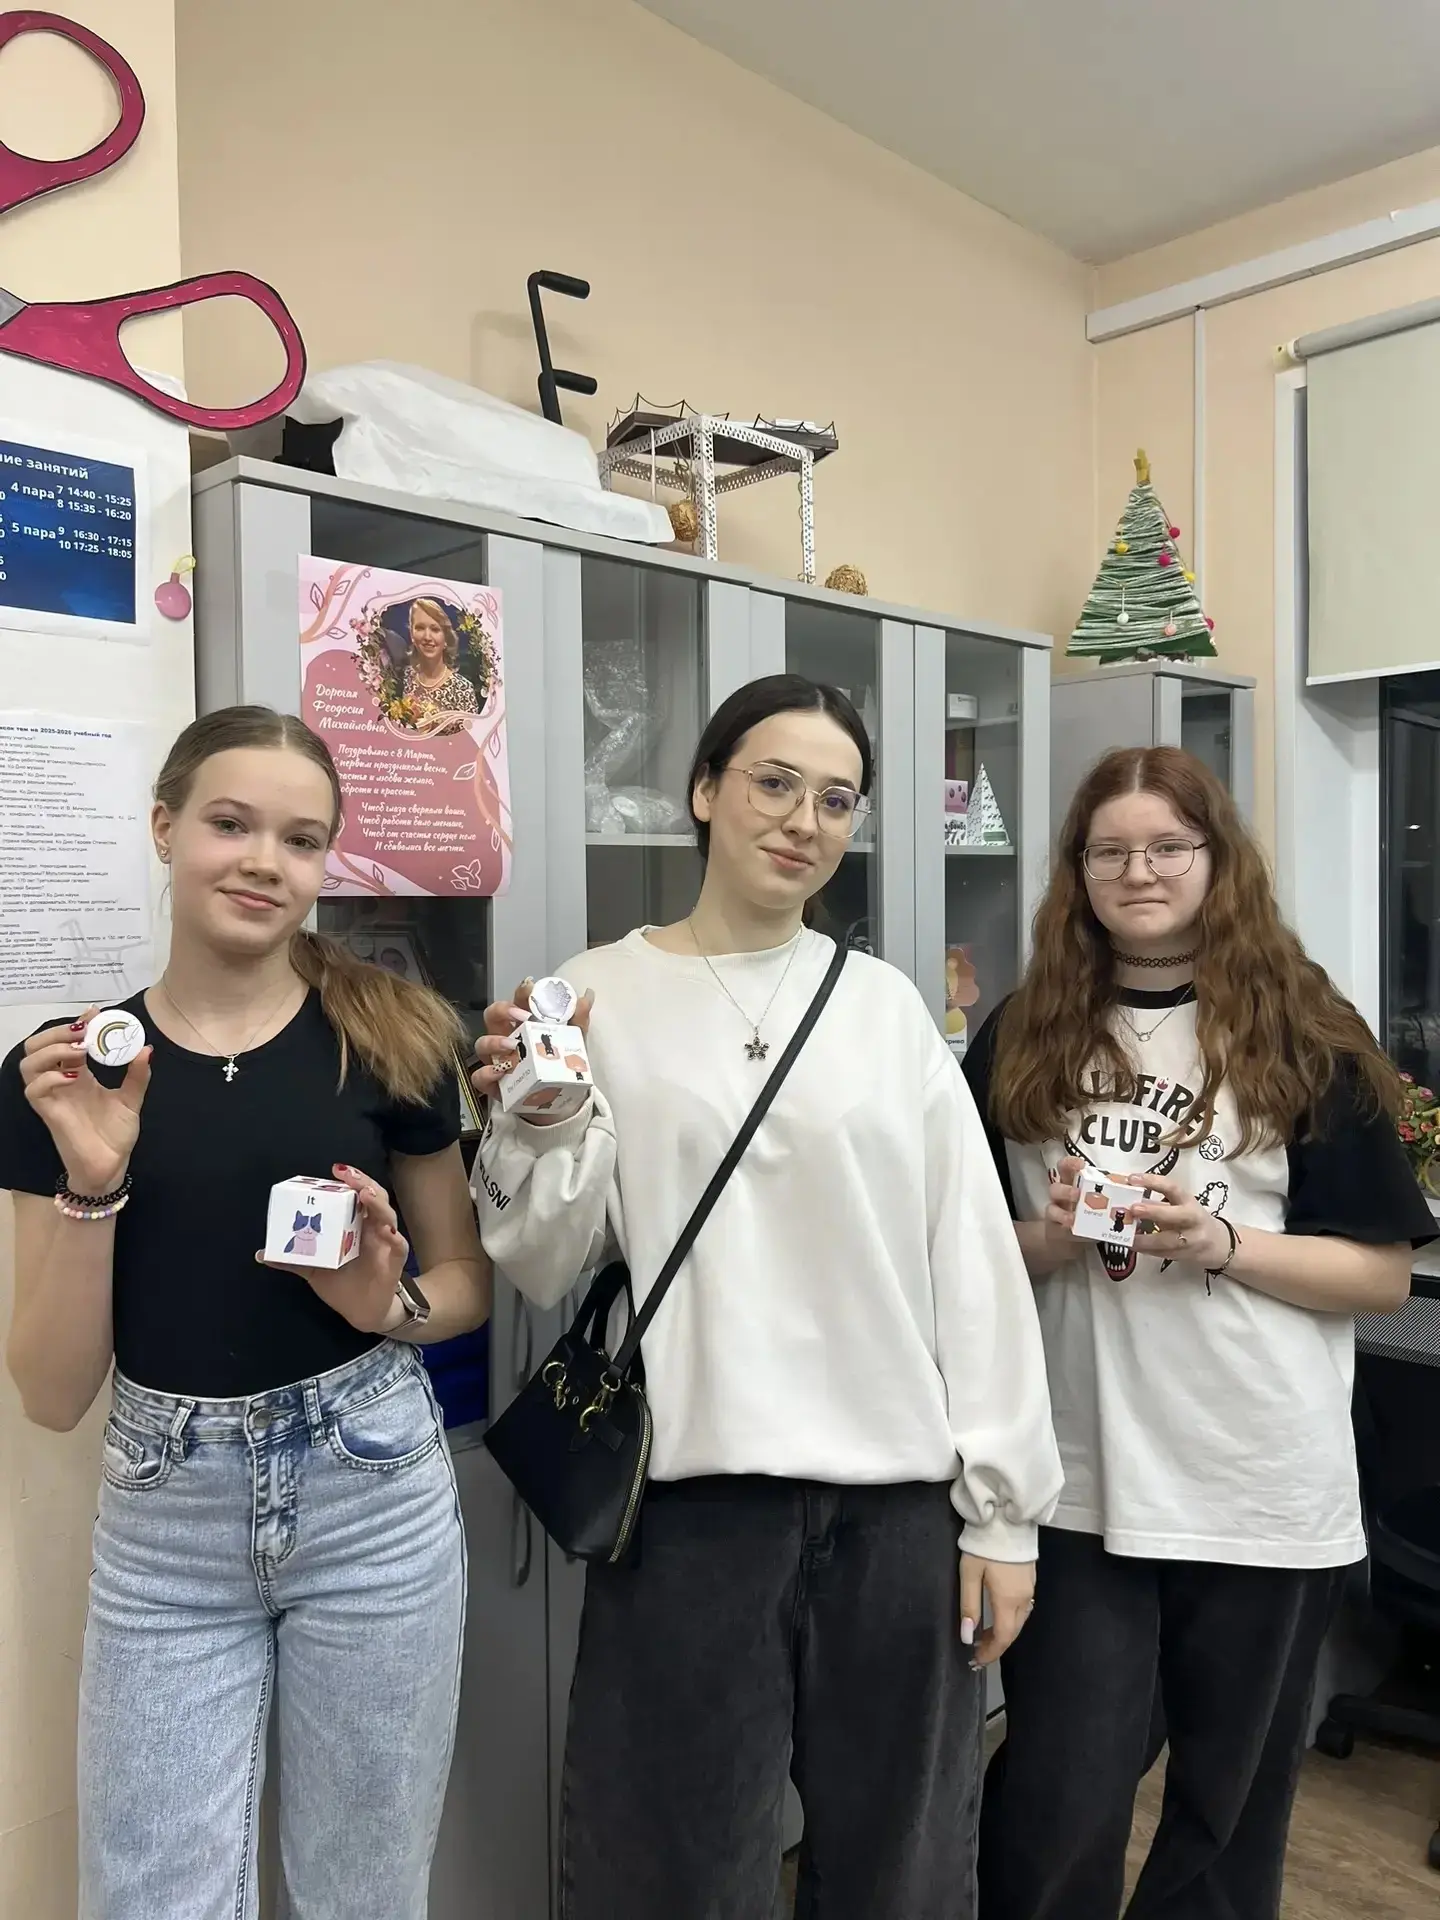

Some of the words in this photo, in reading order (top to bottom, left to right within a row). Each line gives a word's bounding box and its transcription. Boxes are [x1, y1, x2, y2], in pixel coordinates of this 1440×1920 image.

[26, 459, 88, 480] занятий
[11, 482, 19, 492] 4
[22, 486, 55, 500] пара
[56, 485, 64, 494] 7
[68, 487, 96, 500] 14:40
[105, 494, 132, 506] 15:25
[57, 499, 64, 508] 8
[68, 501, 96, 514] 15:35
[104, 508, 132, 520] 16:20
[12, 522, 20, 532] 5
[24, 526, 56, 540] пара
[58, 526, 64, 535] 9
[74, 530, 99, 541] 16:30
[108, 536, 132, 547] 17:15
[58, 540, 71, 550] 10
[74, 542, 99, 553] 17:25
[108, 548, 132, 559] 18:05
[316, 684, 358, 700] Дорогая
[312, 700, 364, 718] Феодосия
[319, 717, 388, 734] Михайловна,
[338, 744, 388, 758] Поздравляю
[396, 748, 402, 758] 8
[404, 749, 436, 762] Марта,
[337, 770, 368, 780] частья
[340, 782, 372, 796] оброты
[362, 802, 385, 812] Чтоб
[386, 806, 406, 816] глаза
[358, 814, 381, 824] Чтоб
[381, 815, 412, 828] работы
[362, 828, 386, 838] Чтоб
[432, 833, 458, 842] сердце
[374, 840, 382, 850] И
[424, 842, 436, 852] все
[1082, 1114, 1162, 1154] CLUB
[306, 1196, 316, 1205] It
